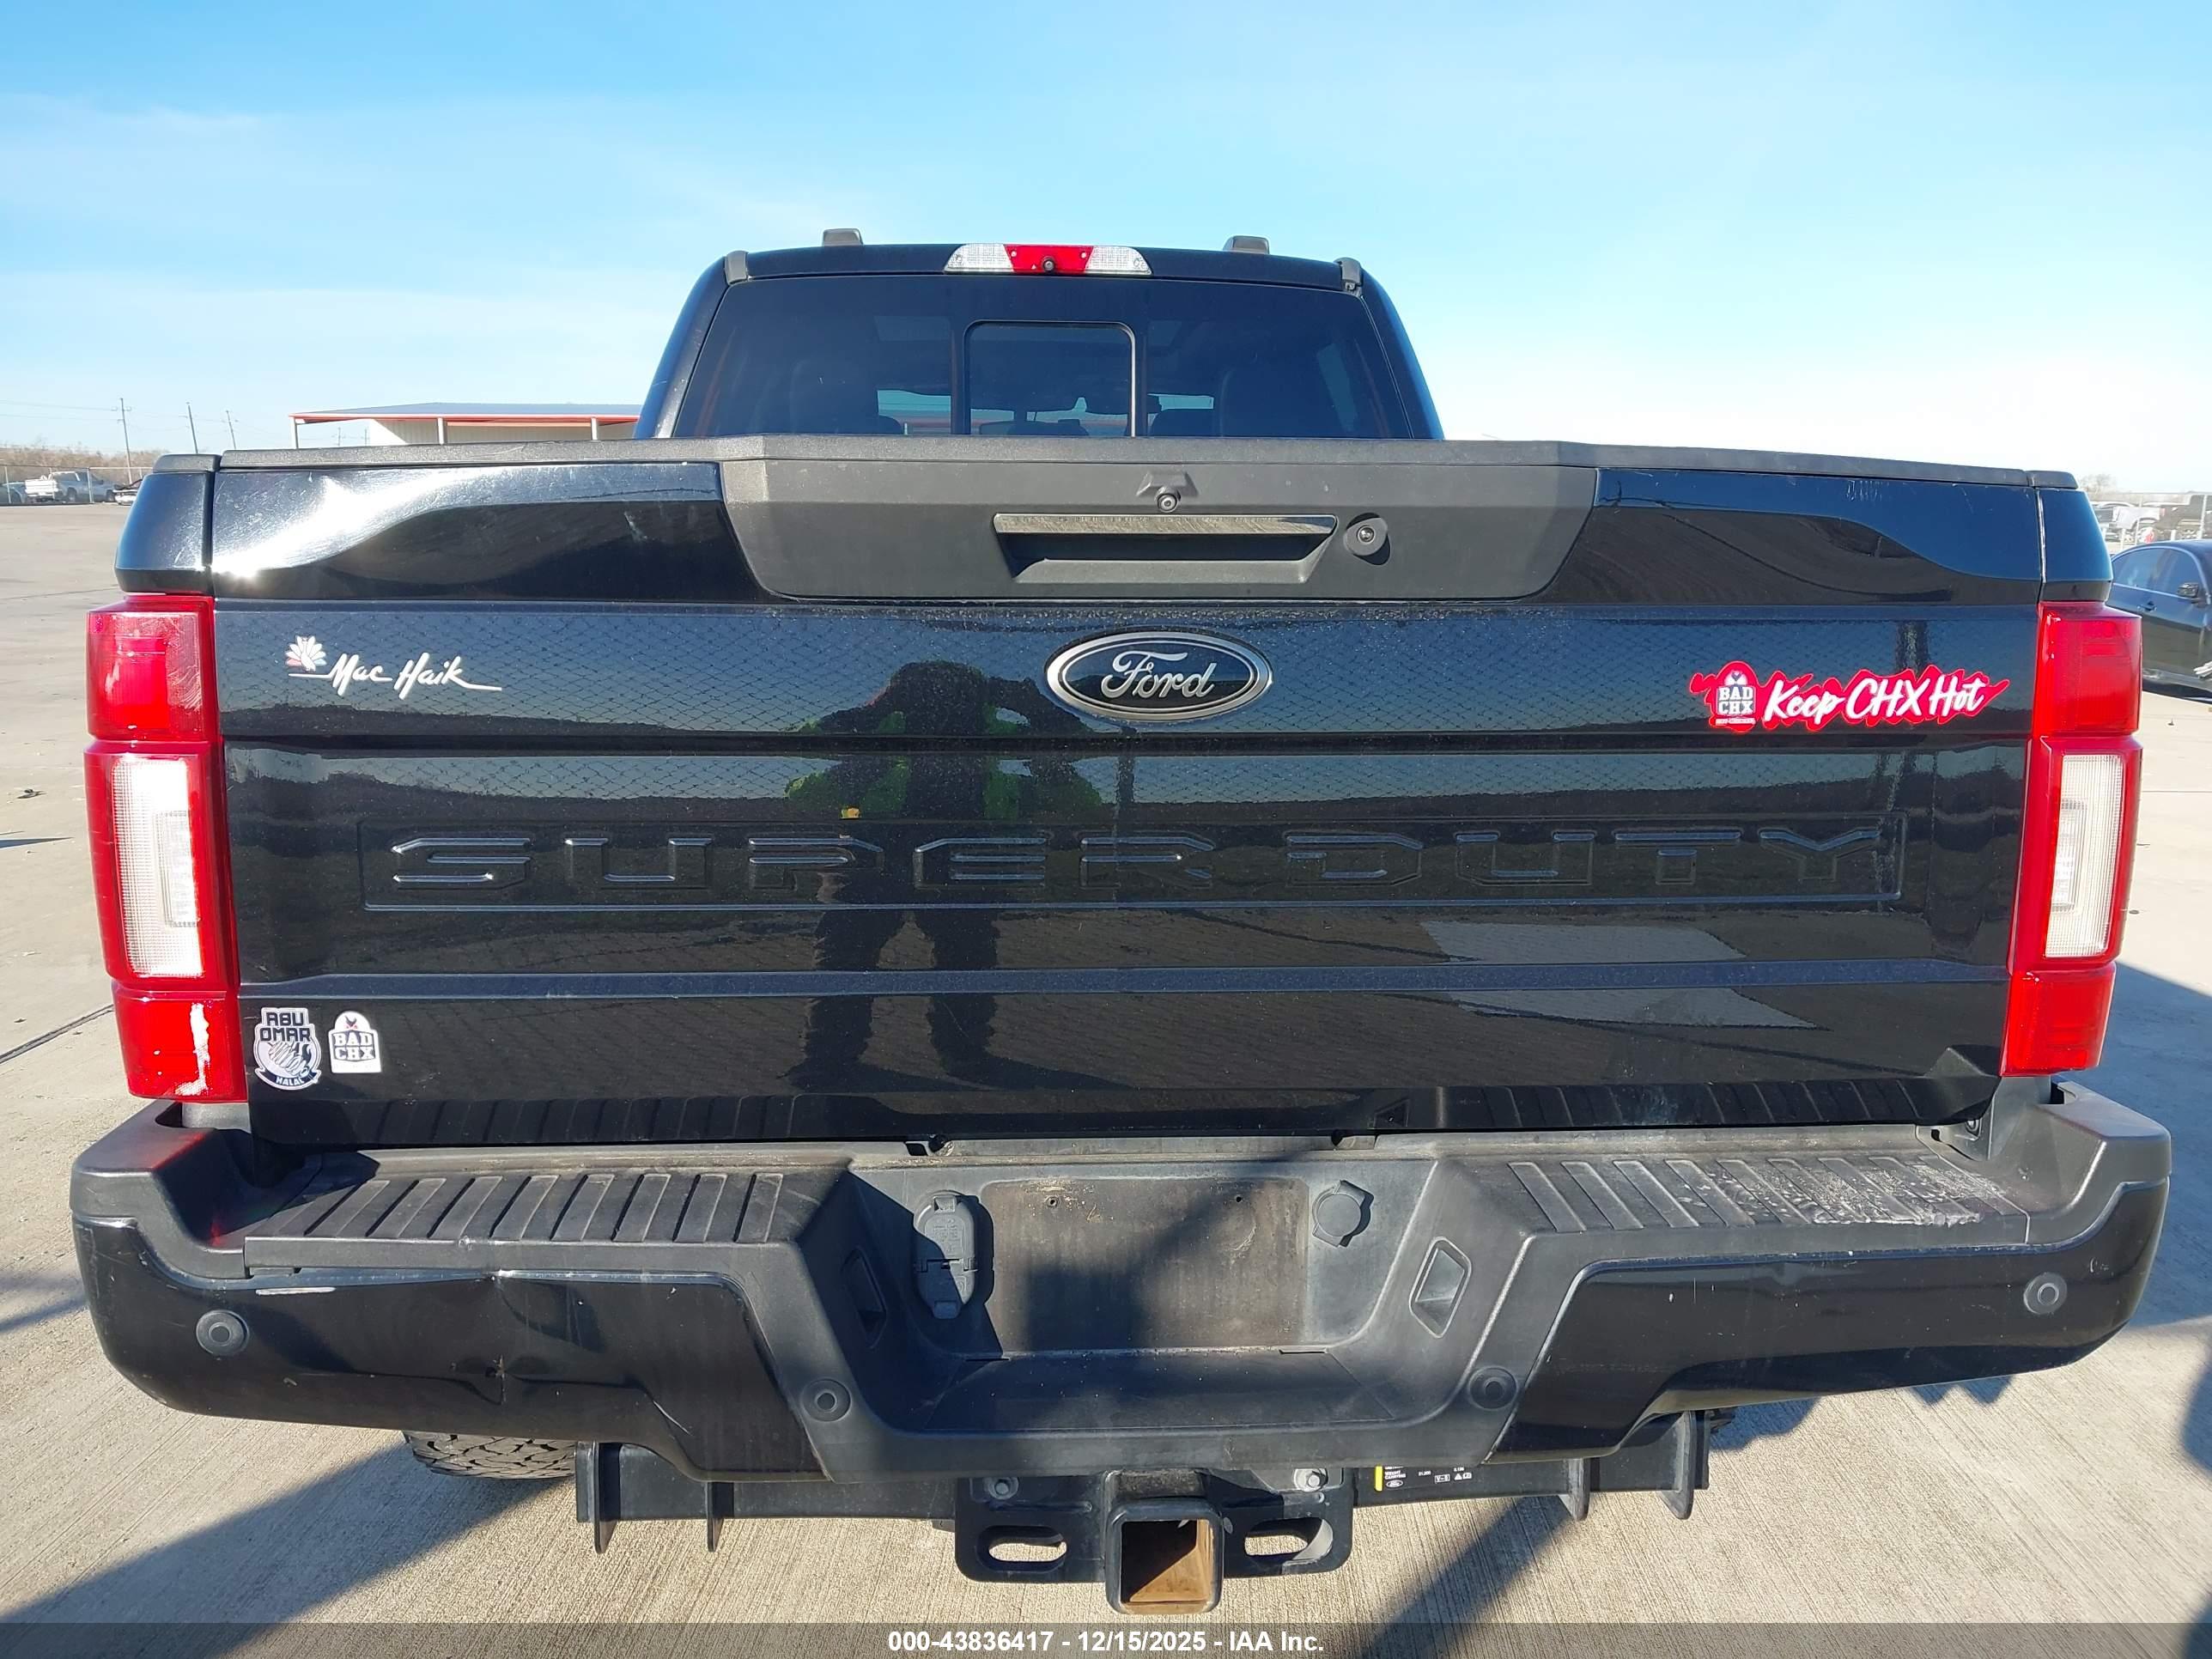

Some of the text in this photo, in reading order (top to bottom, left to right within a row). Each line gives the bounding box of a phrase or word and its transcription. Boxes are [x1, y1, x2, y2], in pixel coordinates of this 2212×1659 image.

[313, 652, 502, 700] Mac Haik
[1101, 650, 1217, 699] Ford
[1718, 686, 1754, 702] BAD
[1765, 678, 1985, 725] Keep CHX Hot
[1717, 700, 1753, 715] CHX
[391, 828, 1884, 890] SUPER DUTY
[265, 1012, 304, 1026] ABU
[259, 1027, 311, 1042] OMAR
[333, 1033, 372, 1046] BAD
[334, 1047, 374, 1060] CHX
[276, 1076, 305, 1086] HALAL
